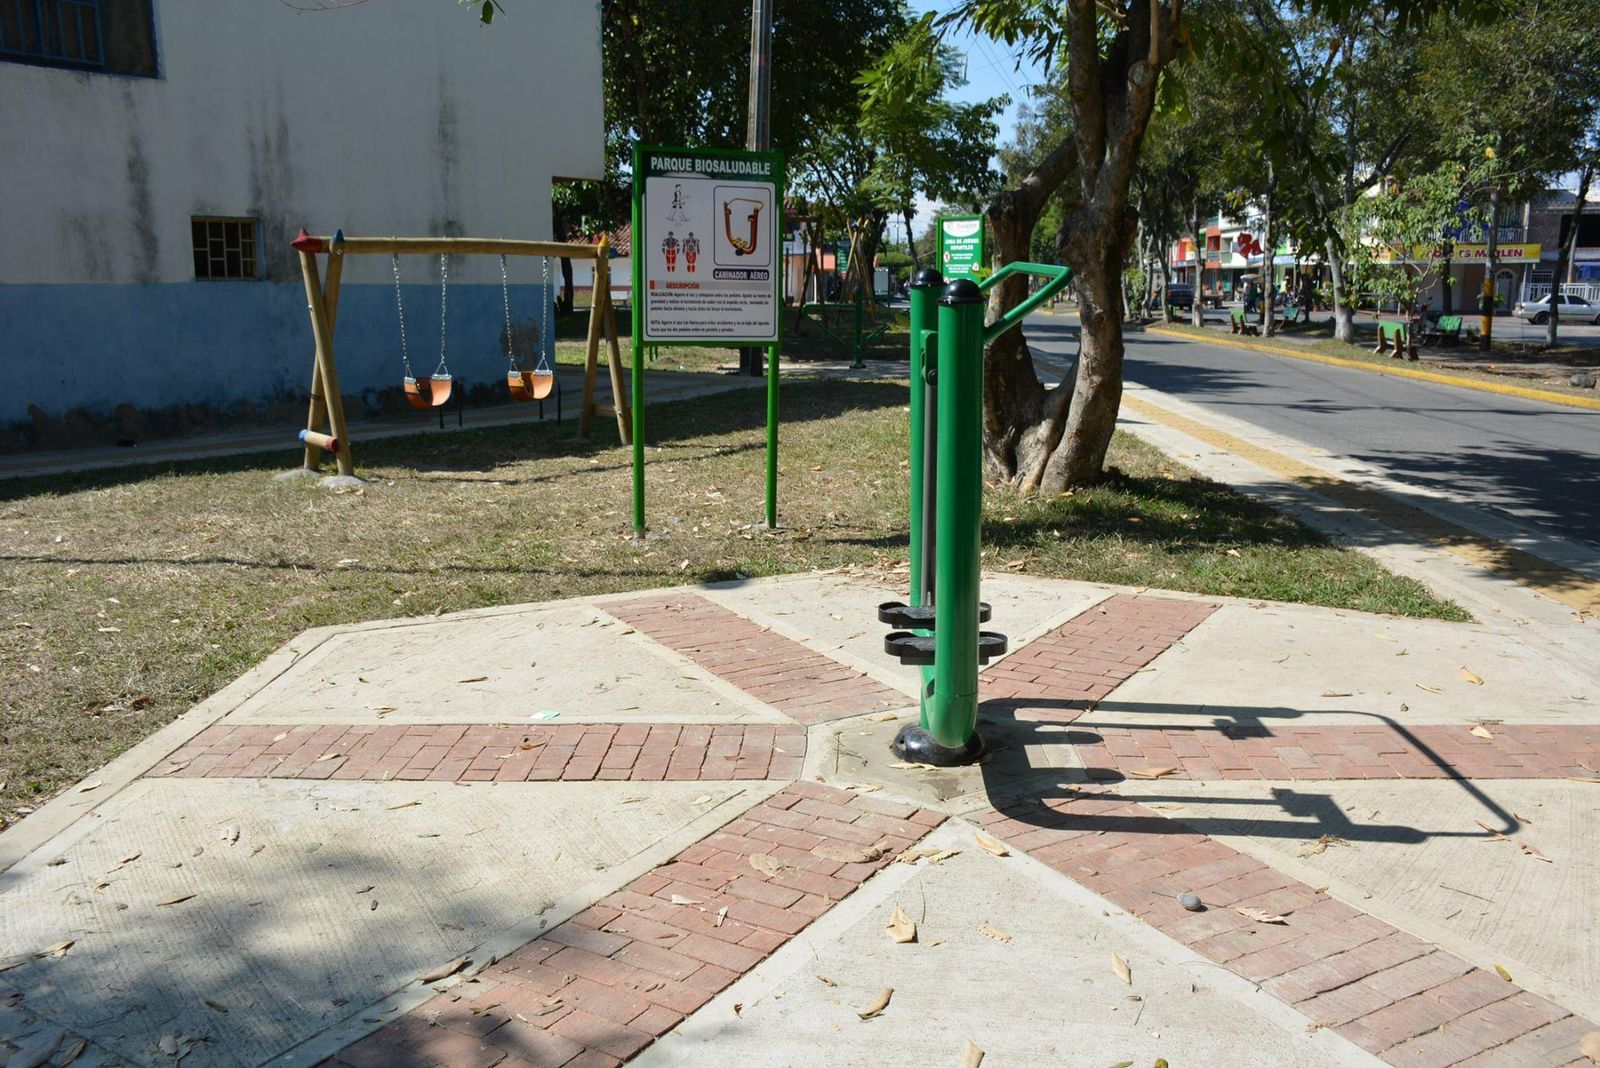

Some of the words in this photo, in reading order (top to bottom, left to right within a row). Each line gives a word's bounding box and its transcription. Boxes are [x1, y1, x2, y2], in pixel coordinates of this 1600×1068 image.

[650, 156, 692, 172] PARQUE
[695, 158, 770, 175] BIOSALUDABLE
[714, 270, 747, 279] CAMINADOR
[750, 270, 768, 279] AÉREO
